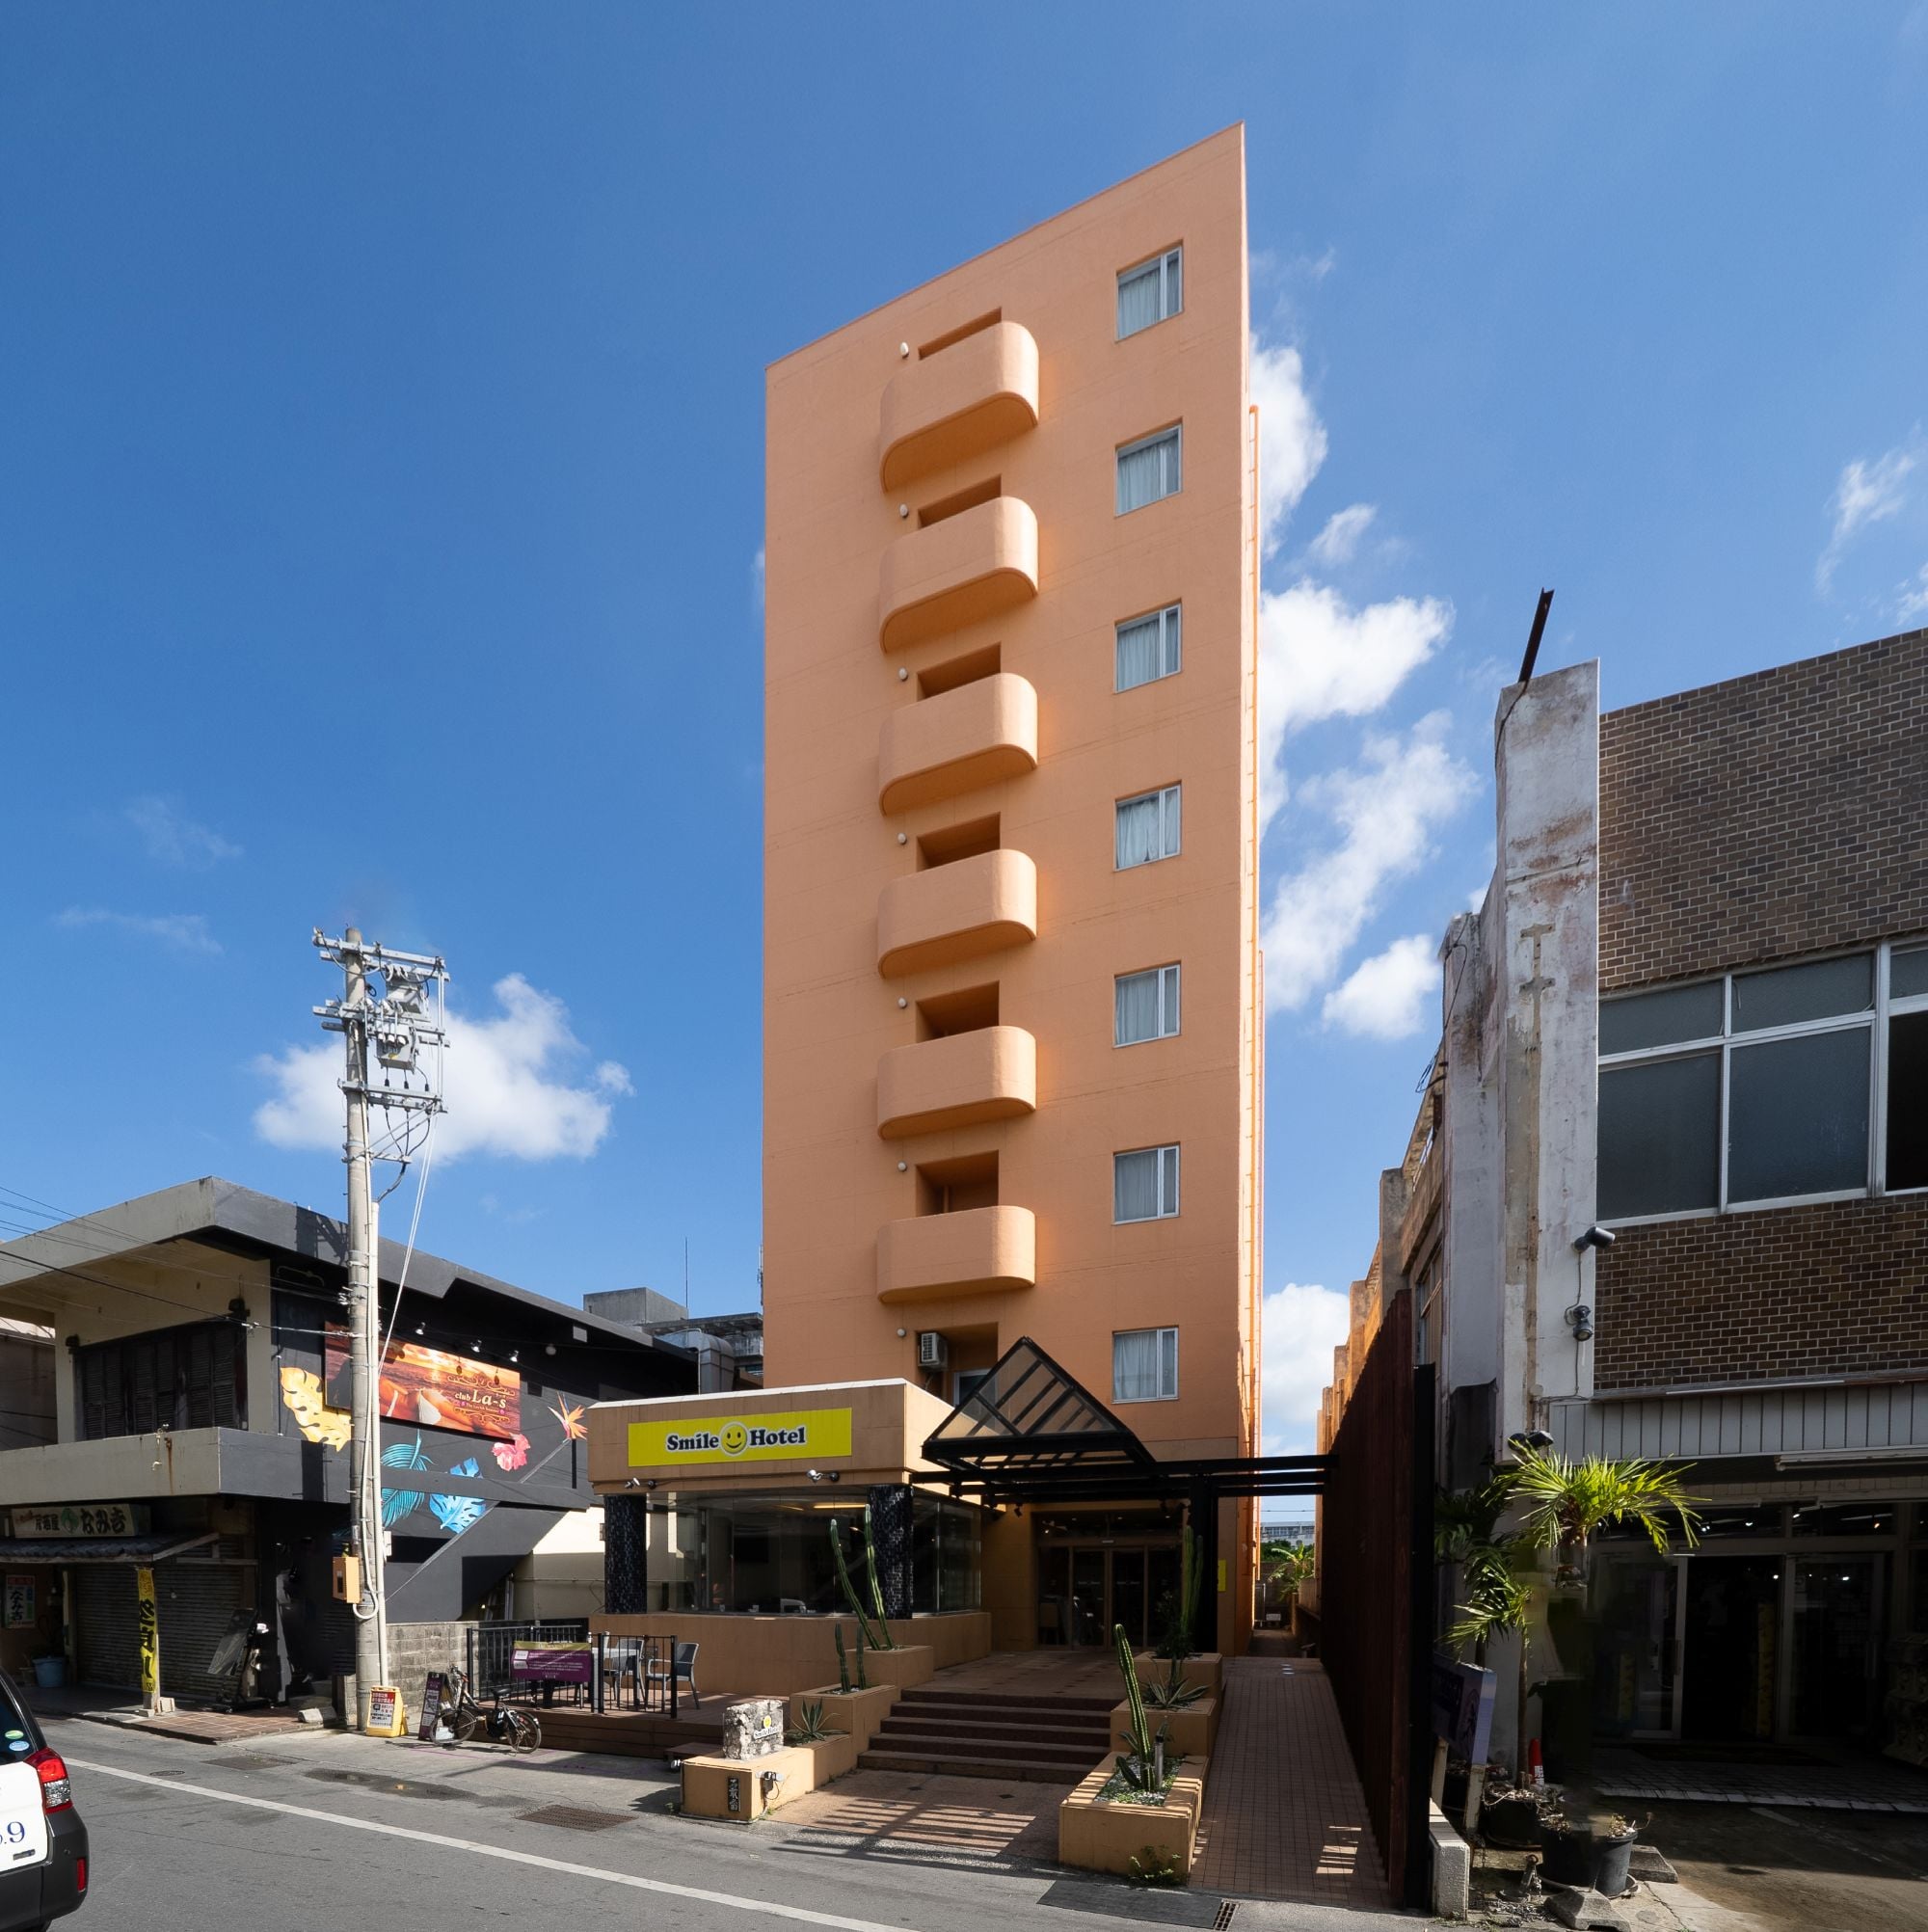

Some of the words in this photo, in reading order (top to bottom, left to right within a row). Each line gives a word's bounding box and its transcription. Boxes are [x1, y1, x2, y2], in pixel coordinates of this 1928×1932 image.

[455, 1392, 470, 1401] club
[472, 1389, 506, 1409] La-s
[667, 1433, 719, 1450] Smile
[750, 1427, 806, 1446] Hotel
[35, 1514, 60, 1531] 居酒屋
[80, 1506, 126, 1535] なみ吉
